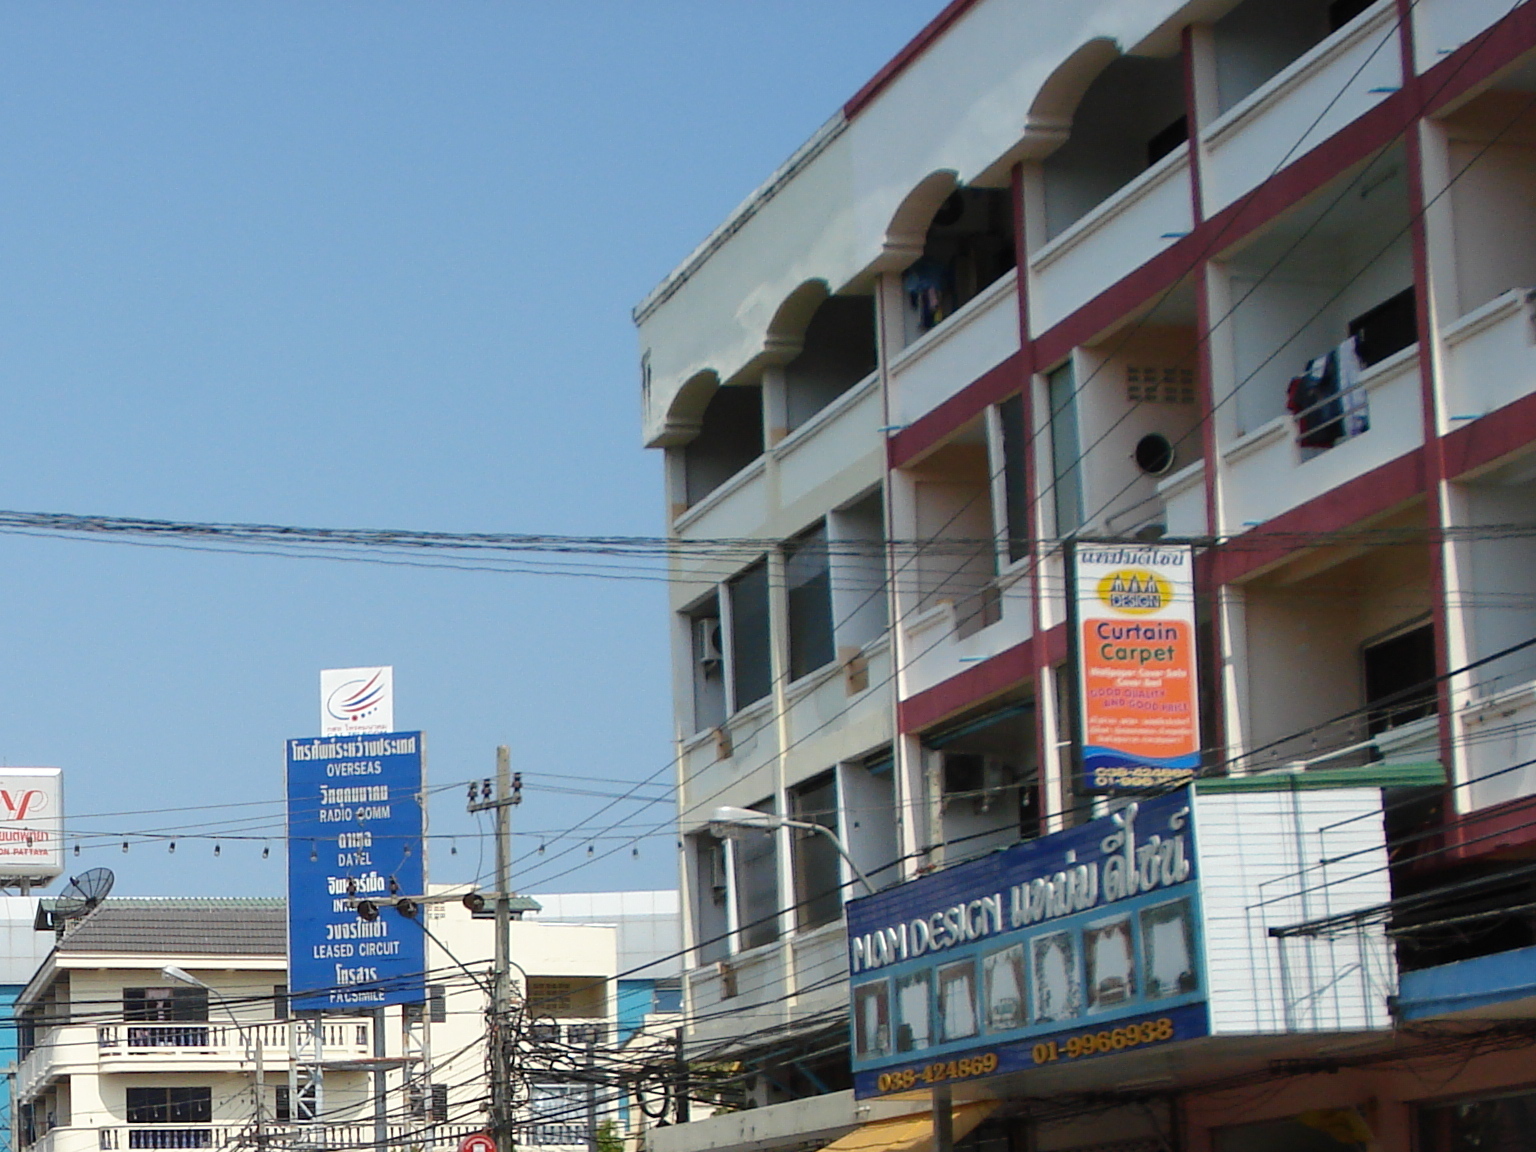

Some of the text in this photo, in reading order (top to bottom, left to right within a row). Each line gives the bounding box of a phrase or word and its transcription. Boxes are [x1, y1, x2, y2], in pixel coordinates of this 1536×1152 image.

[1111, 594, 1161, 607] DESIGN
[1097, 622, 1177, 640] Curtain
[1101, 643, 1175, 665] Carpet
[1090, 688, 1165, 698] GOOD QUALITY
[1129, 701, 1158, 710] GOOD
[326, 761, 382, 777] OVERSEAS
[319, 805, 390, 822] RADIO COMM
[13, 847, 48, 855] PATTAYA
[338, 852, 372, 867] DATEL
[1010, 850, 1098, 928] แหม่ม
[853, 892, 1002, 972] MAM DESIGN
[314, 941, 400, 958] LEASED CIRCUIT
[330, 987, 385, 1003] FACSIMILE
[877, 1018, 1174, 1092] 038-424869 01-9966938
